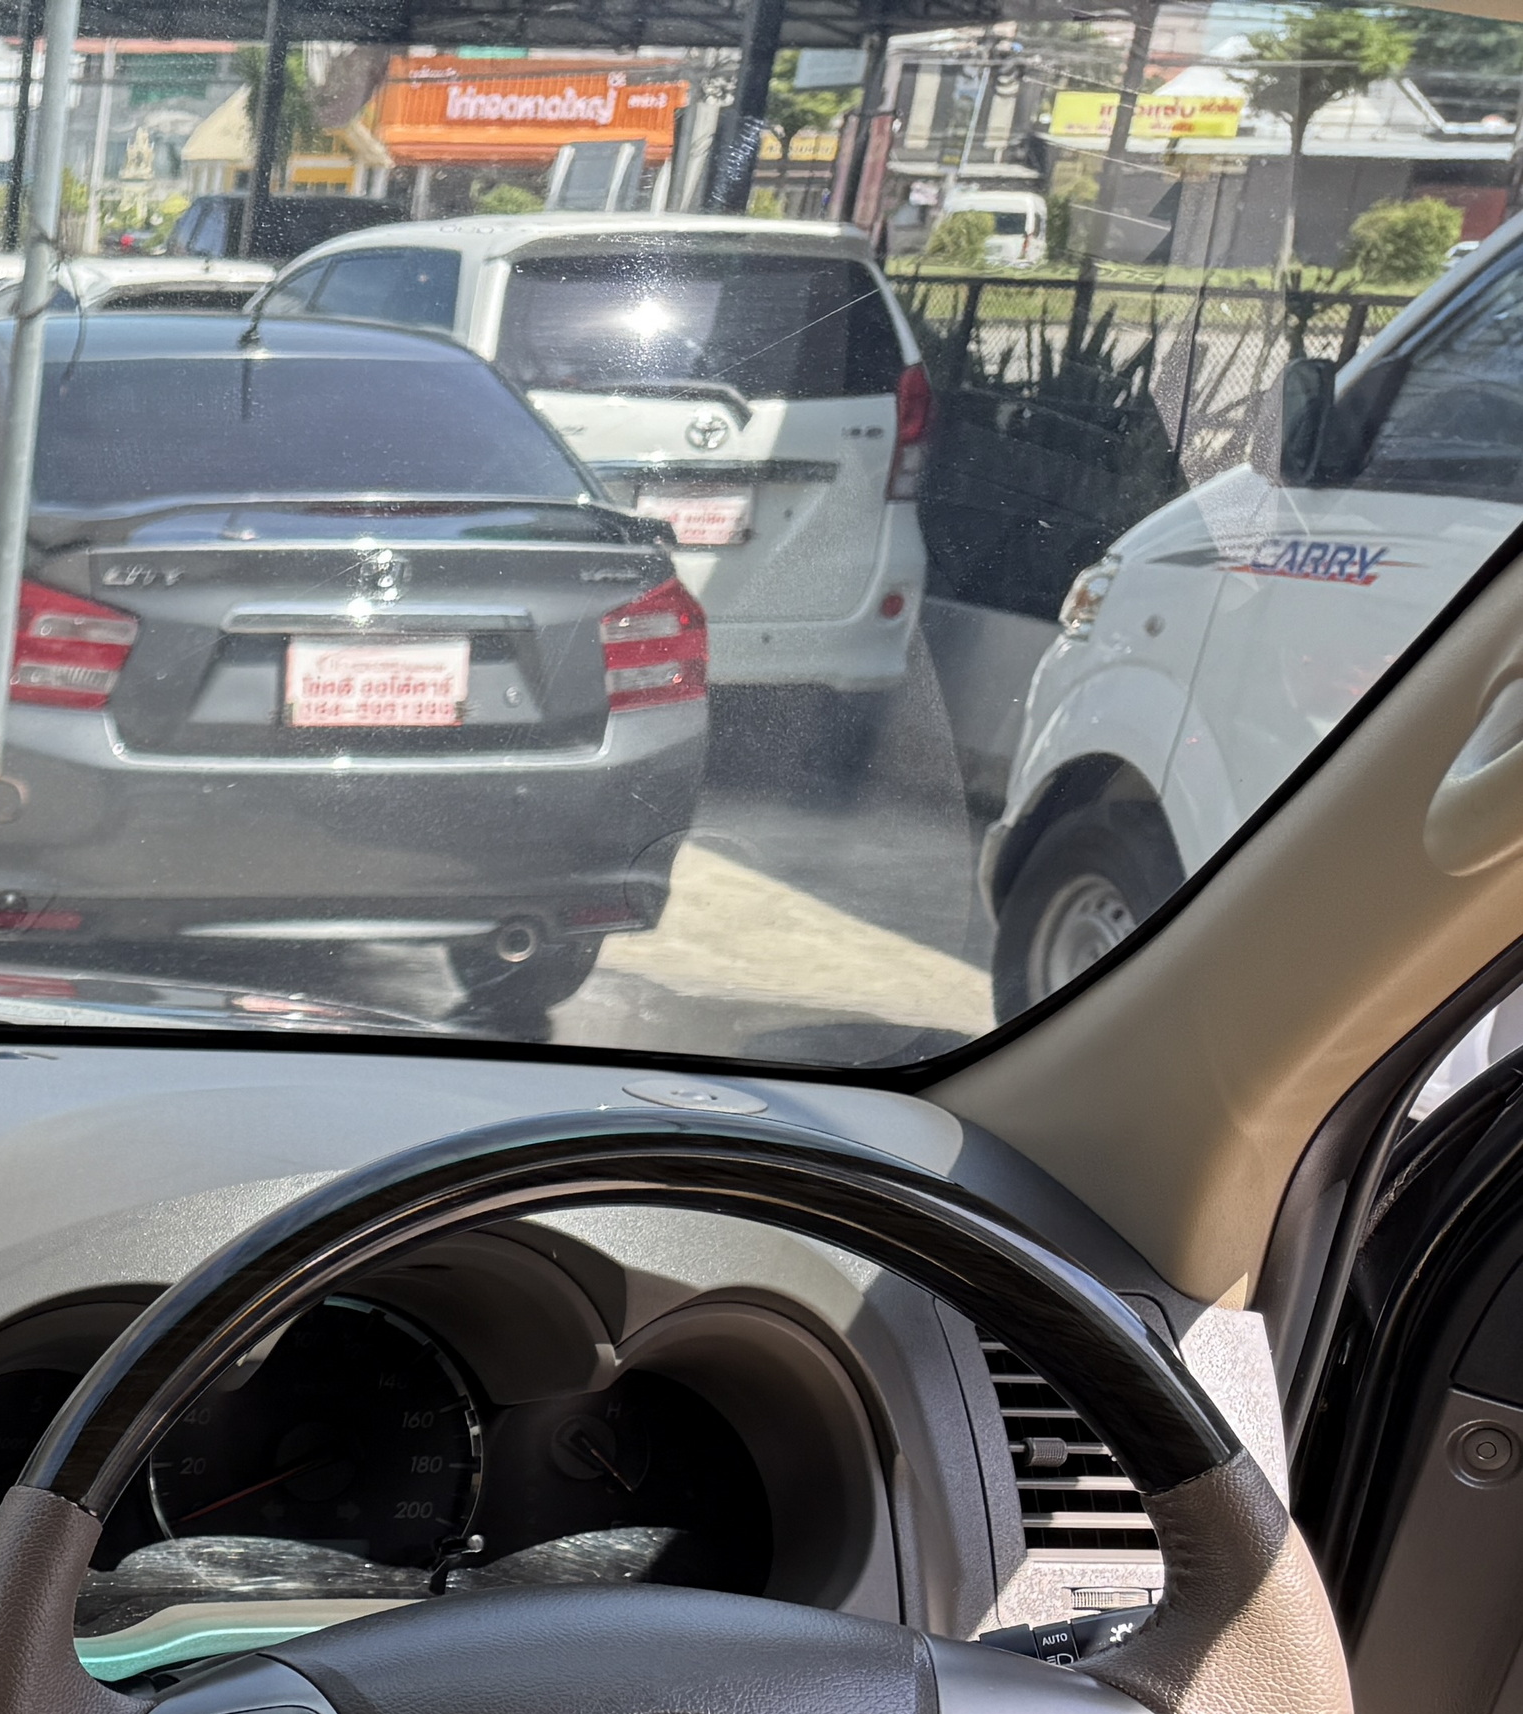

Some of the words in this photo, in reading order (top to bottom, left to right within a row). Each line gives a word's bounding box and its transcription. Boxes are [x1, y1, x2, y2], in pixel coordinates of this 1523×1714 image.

[1251, 539, 1388, 579] CARRY
[401, 1411, 435, 1430] 160
[180, 1458, 206, 1475] 20
[410, 1455, 443, 1474] 180
[393, 1502, 433, 1519] 200
[1042, 1632, 1068, 1646] AUTO
